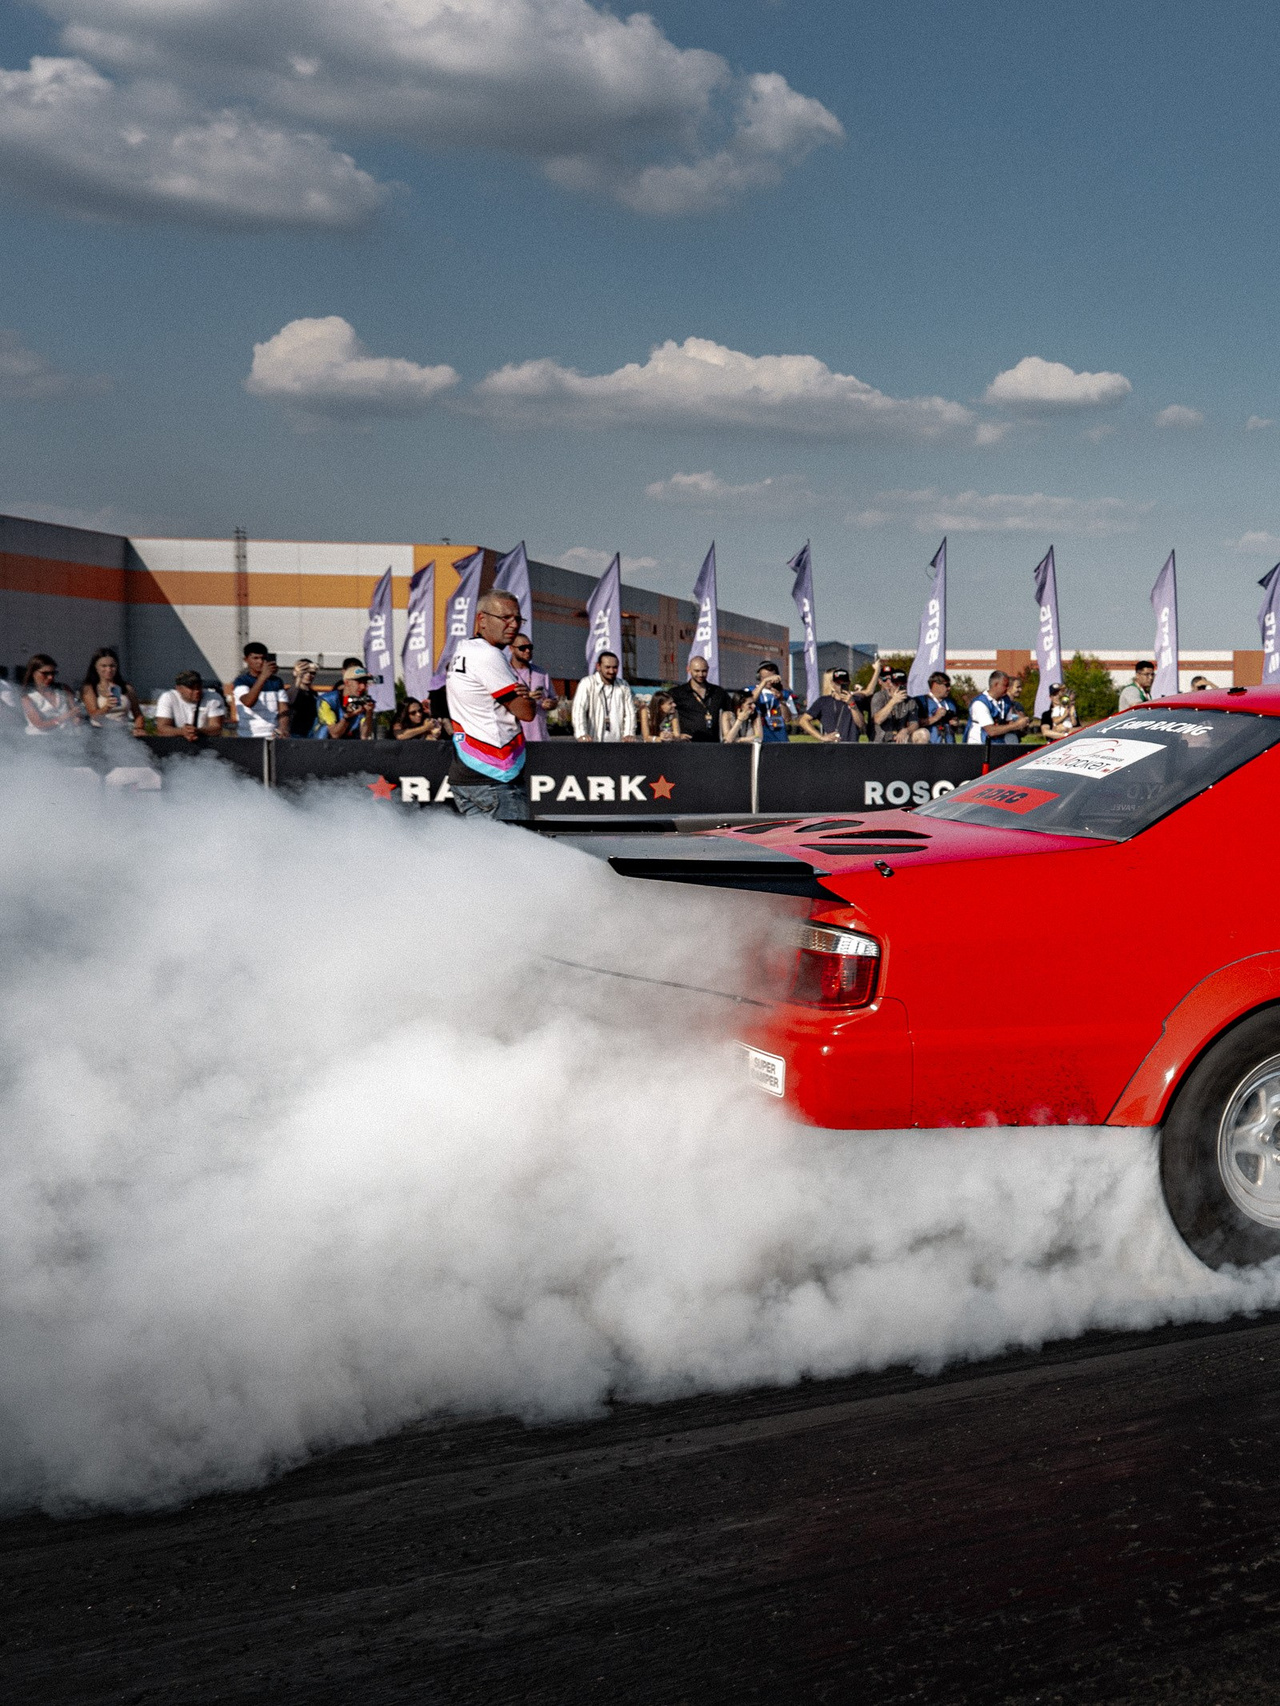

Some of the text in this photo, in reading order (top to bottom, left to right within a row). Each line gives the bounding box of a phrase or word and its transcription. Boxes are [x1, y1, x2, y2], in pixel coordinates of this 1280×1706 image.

[1145, 721, 1213, 736] RACING
[399, 775, 647, 802] RA PARK
[864, 780, 971, 805] ROSG
